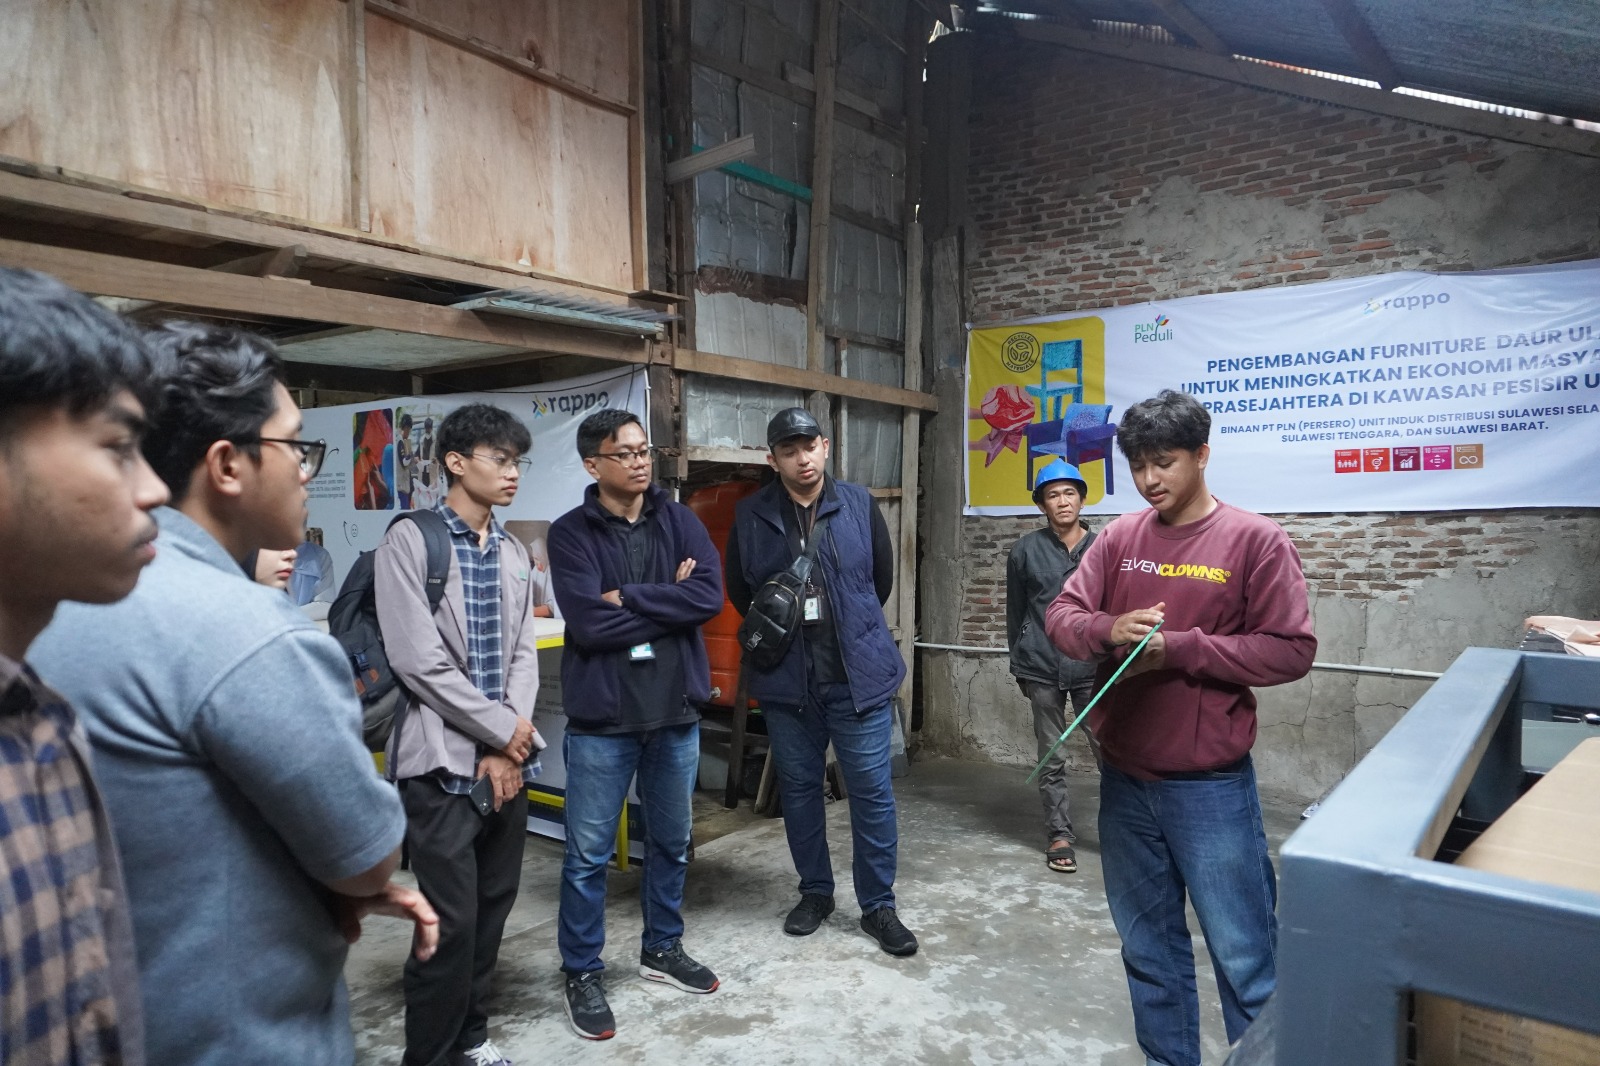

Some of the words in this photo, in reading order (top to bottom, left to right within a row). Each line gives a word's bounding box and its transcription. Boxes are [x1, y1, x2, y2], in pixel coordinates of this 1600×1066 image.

[1384, 292, 1450, 310] rappo
[1135, 323, 1154, 332] PLN
[1135, 328, 1173, 343] Peduli
[1207, 347, 1365, 373] PENGEMBANGAN
[1370, 336, 1486, 360] FURNITURE
[1496, 329, 1562, 350] DAUR
[1569, 326, 1600, 342] UL
[1181, 379, 1240, 395] UNTUK
[1244, 366, 1403, 392] MENINGKATKAN
[1408, 357, 1512, 380] EKONOMI
[547, 391, 609, 416] rappo
[1202, 393, 1344, 414] PRASEJAHTERA
[1349, 391, 1369, 406] DI
[1373, 382, 1486, 404] KAWASAN
[1493, 374, 1578, 396] PESISIR
[1221, 424, 1260, 434] BINAAN
[1262, 423, 1274, 432] PT
[1276, 422, 1296, 431] PLN
[1299, 417, 1356, 432] (PERSERO)
[1358, 417, 1384, 427] UNIT
[1387, 415, 1424, 426] INDUK
[1427, 411, 1495, 423] DISTRIBUSI
[1497, 406, 1564, 419] SULAWESI
[1281, 432, 1335, 442] SULAWESI
[1337, 429, 1403, 440] TENGGARA,
[1406, 428, 1432, 437] DAN
[1435, 424, 1498, 435] SULAWESI
[1501, 421, 1549, 432] BARAT.
